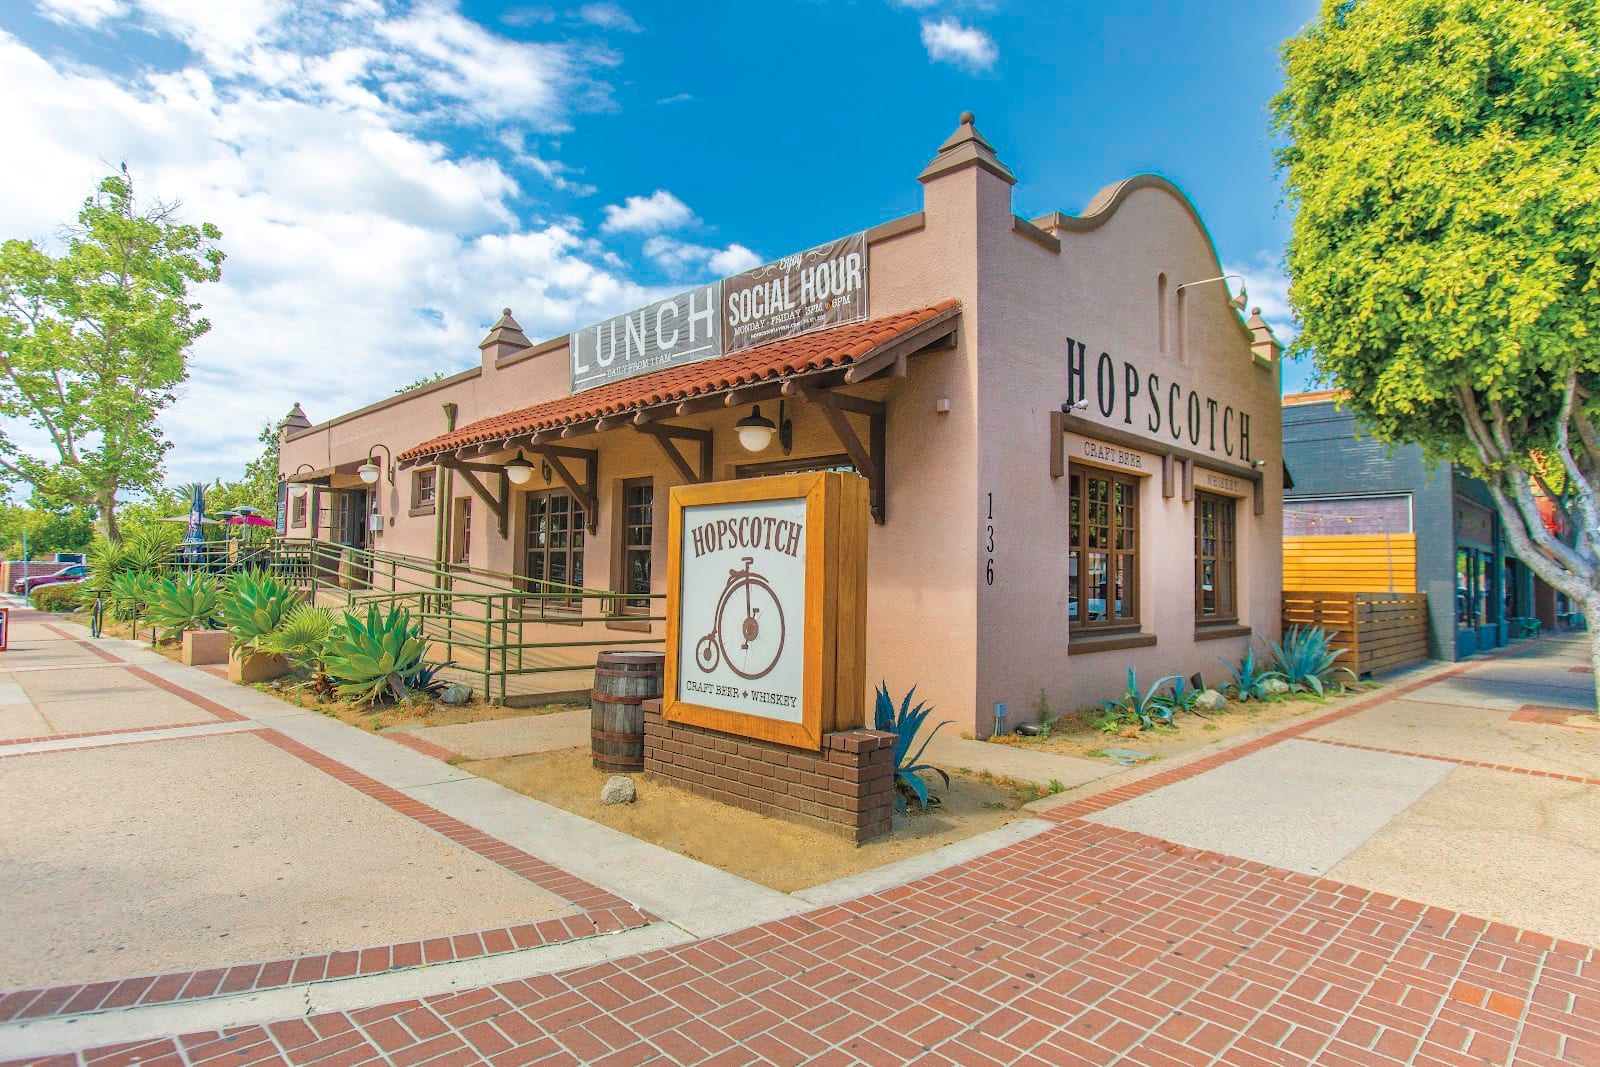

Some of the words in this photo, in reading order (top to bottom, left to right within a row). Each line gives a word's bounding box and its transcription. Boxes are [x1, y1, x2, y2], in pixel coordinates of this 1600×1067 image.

[779, 253, 803, 273] Enjoy
[728, 275, 796, 327] SOCIAL
[800, 252, 862, 304] HOUR
[573, 287, 715, 375] LUNCH
[734, 318, 766, 336] MONDAY
[771, 308, 802, 326] FRIDAY
[831, 294, 851, 308] 6PM
[1066, 337, 1251, 463] HOPSCOTCH
[1084, 441, 1116, 462] CRAFT
[1117, 449, 1142, 469] BEER
[691, 516, 803, 558] HOPSCOTCH
[986, 492, 994, 586] 136
[686, 680, 714, 694] CRAFT
[715, 685, 740, 699] BEER
[751, 690, 798, 708] WHISKEY
